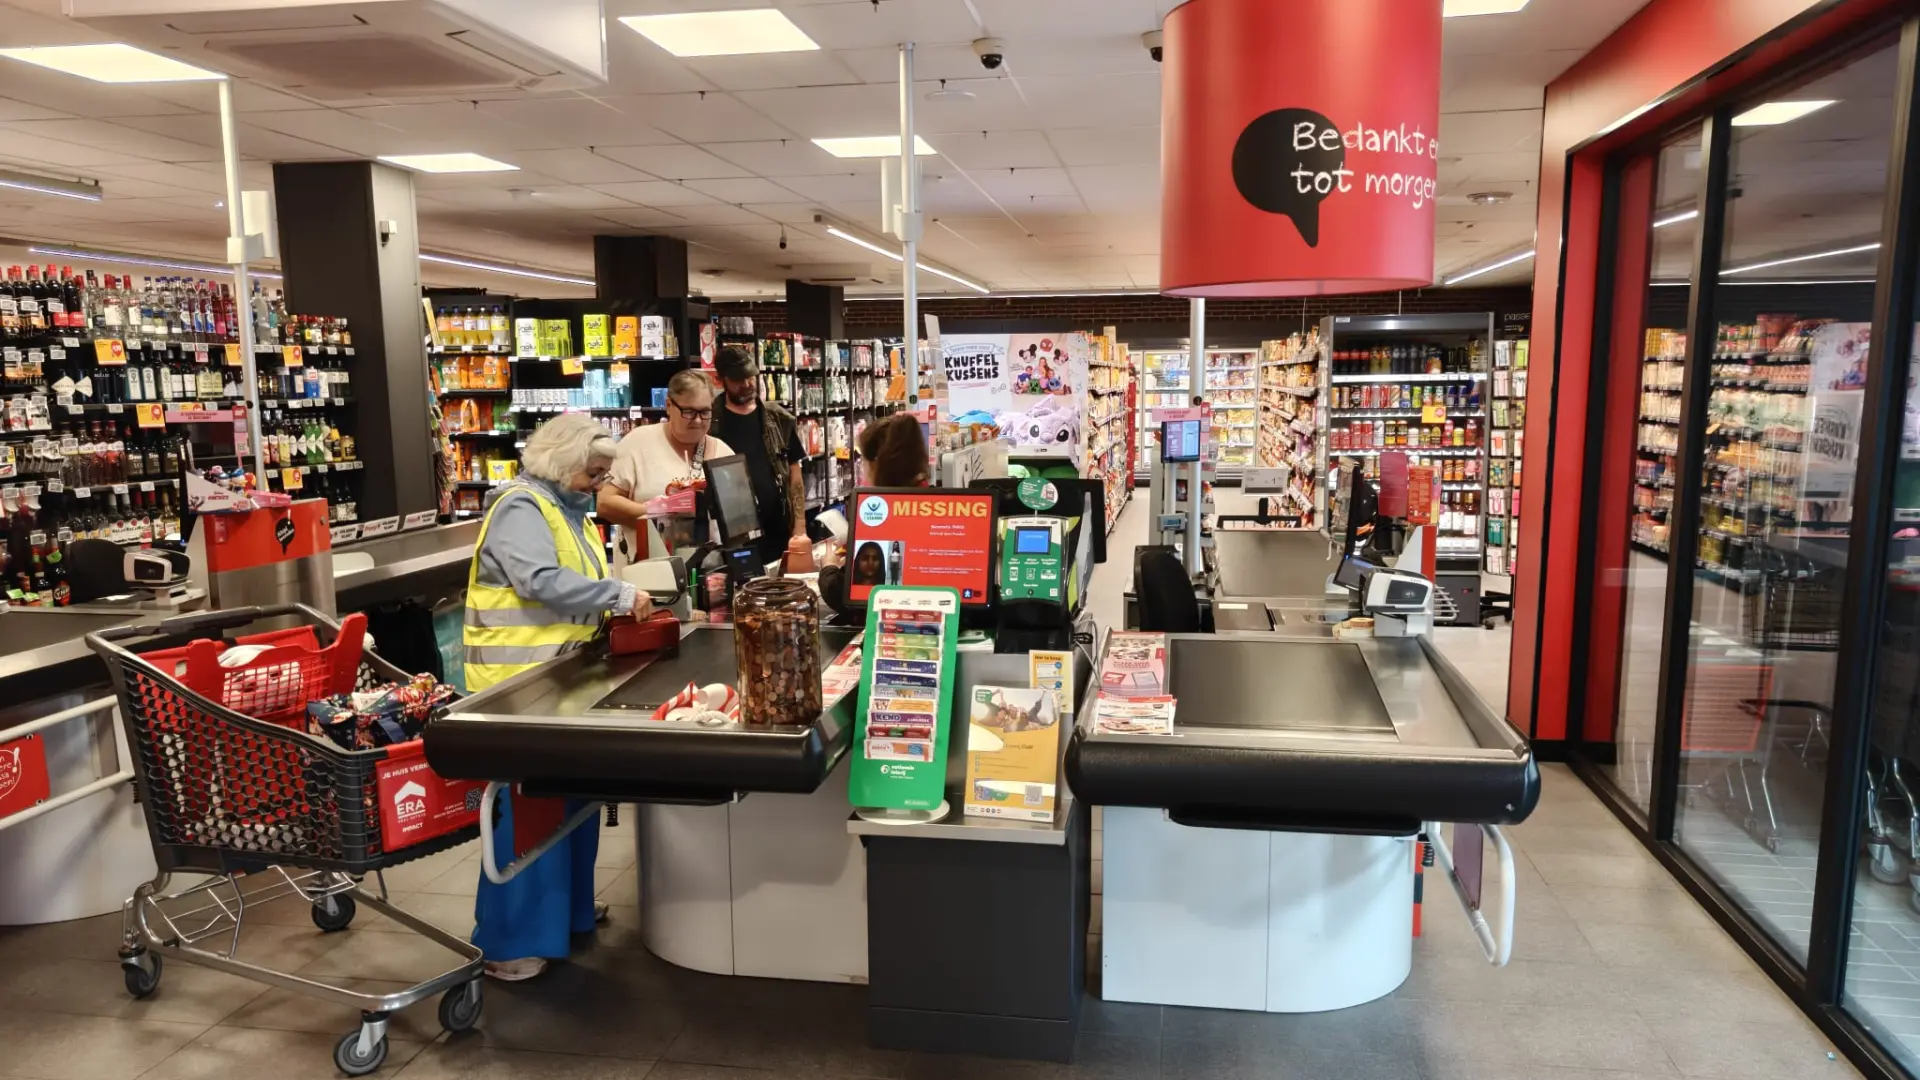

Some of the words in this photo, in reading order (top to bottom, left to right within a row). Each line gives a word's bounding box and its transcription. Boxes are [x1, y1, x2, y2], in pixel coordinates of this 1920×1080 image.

[1292, 121, 1425, 156] Bedankt
[1290, 162, 1354, 194] tot
[944, 353, 999, 369] KNUFFEL
[945, 366, 999, 382] KUSSENS
[893, 500, 988, 518] MISSING
[392, 767, 409, 778] HUIS
[410, 761, 430, 773] VERK
[396, 799, 426, 816] ERA
